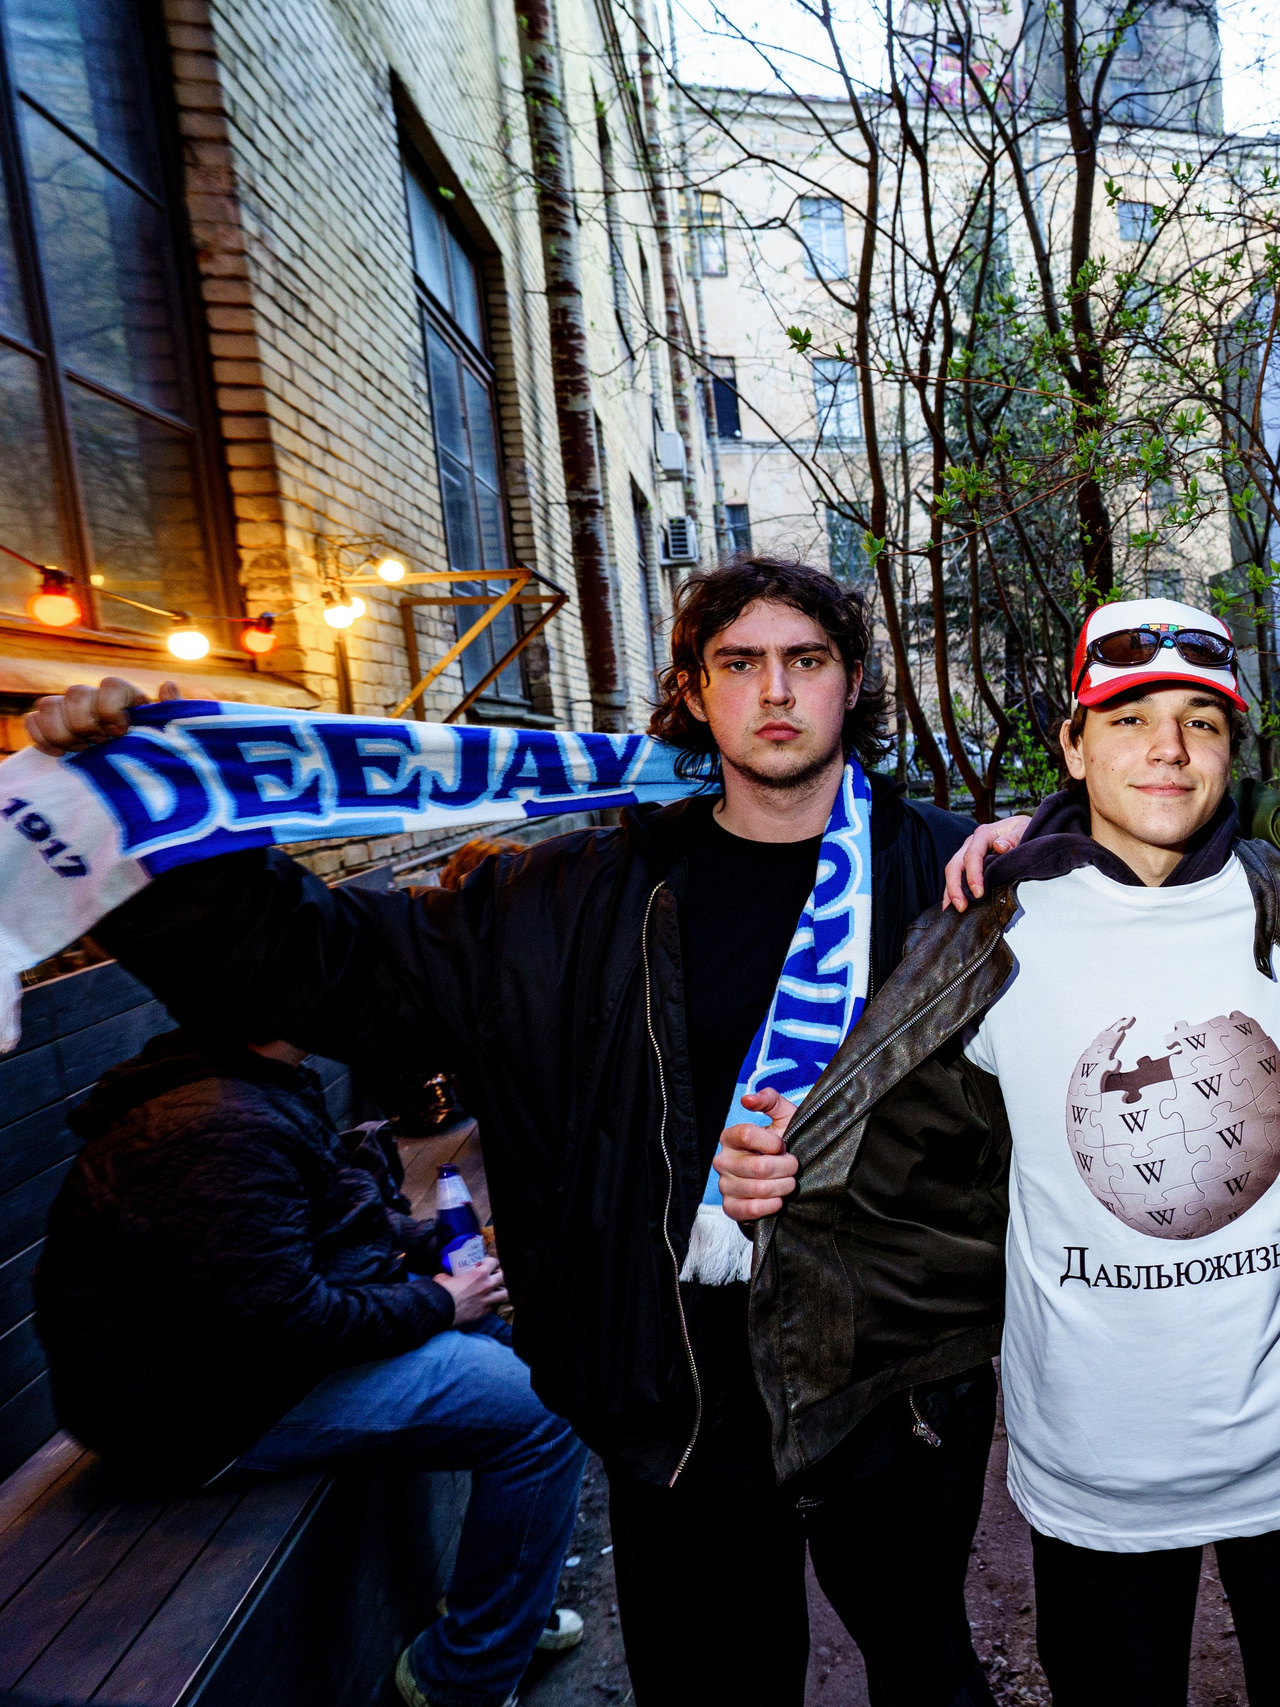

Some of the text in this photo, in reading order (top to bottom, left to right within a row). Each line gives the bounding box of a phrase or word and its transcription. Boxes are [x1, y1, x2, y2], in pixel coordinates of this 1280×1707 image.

[66, 720, 650, 853] DEEJAY
[2, 797, 90, 880] 1917
[1183, 1033, 1207, 1051] W
[1081, 1062, 1099, 1078] W
[1258, 1055, 1277, 1076] W
[1192, 1073, 1223, 1100] W
[1071, 1105, 1089, 1125] W
[1119, 1109, 1149, 1134] W
[1216, 1121, 1246, 1150] W
[1075, 1150, 1093, 1173] W
[1133, 1159, 1166, 1184] W
[1223, 1171, 1251, 1196] W
[1146, 1208, 1176, 1226] W
